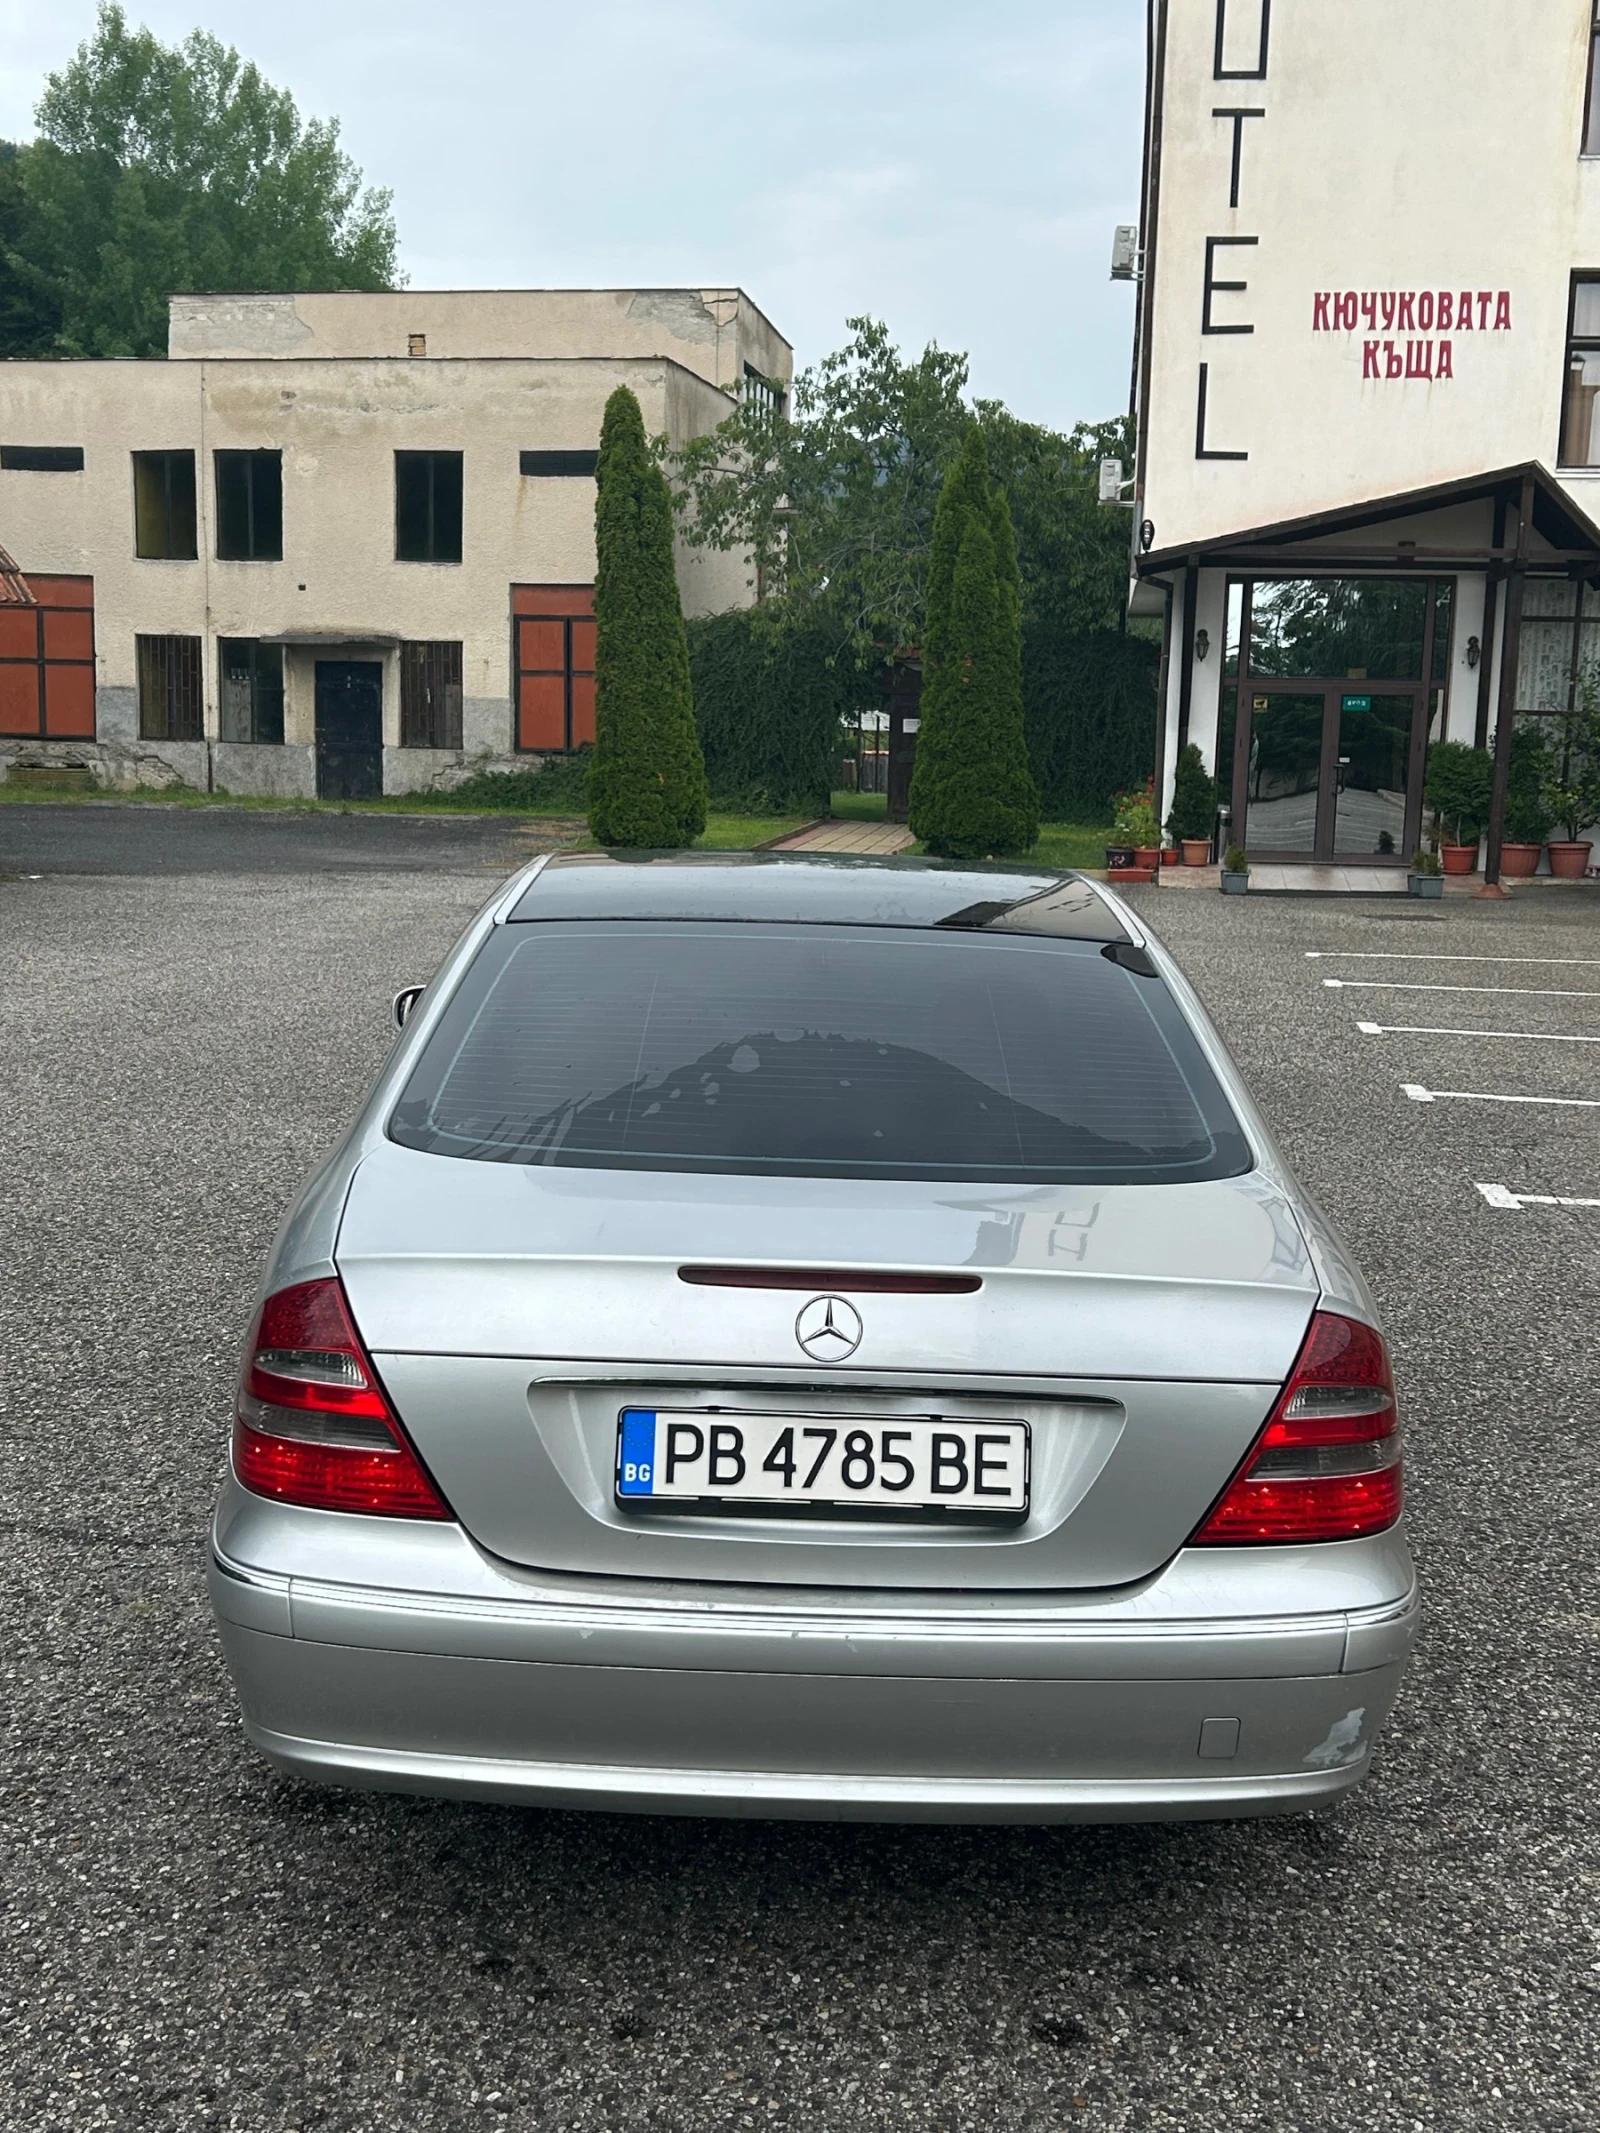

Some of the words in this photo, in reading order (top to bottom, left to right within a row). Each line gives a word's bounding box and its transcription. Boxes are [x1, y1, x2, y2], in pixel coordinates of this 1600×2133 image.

[1313, 291, 1512, 331] КЮЧУКОВАТА
[1363, 340, 1453, 382] КЪЩА
[624, 1462, 651, 1483] BG
[665, 1423, 746, 1486] PB
[762, 1427, 915, 1492] 4785
[931, 1433, 1012, 1496] BE
